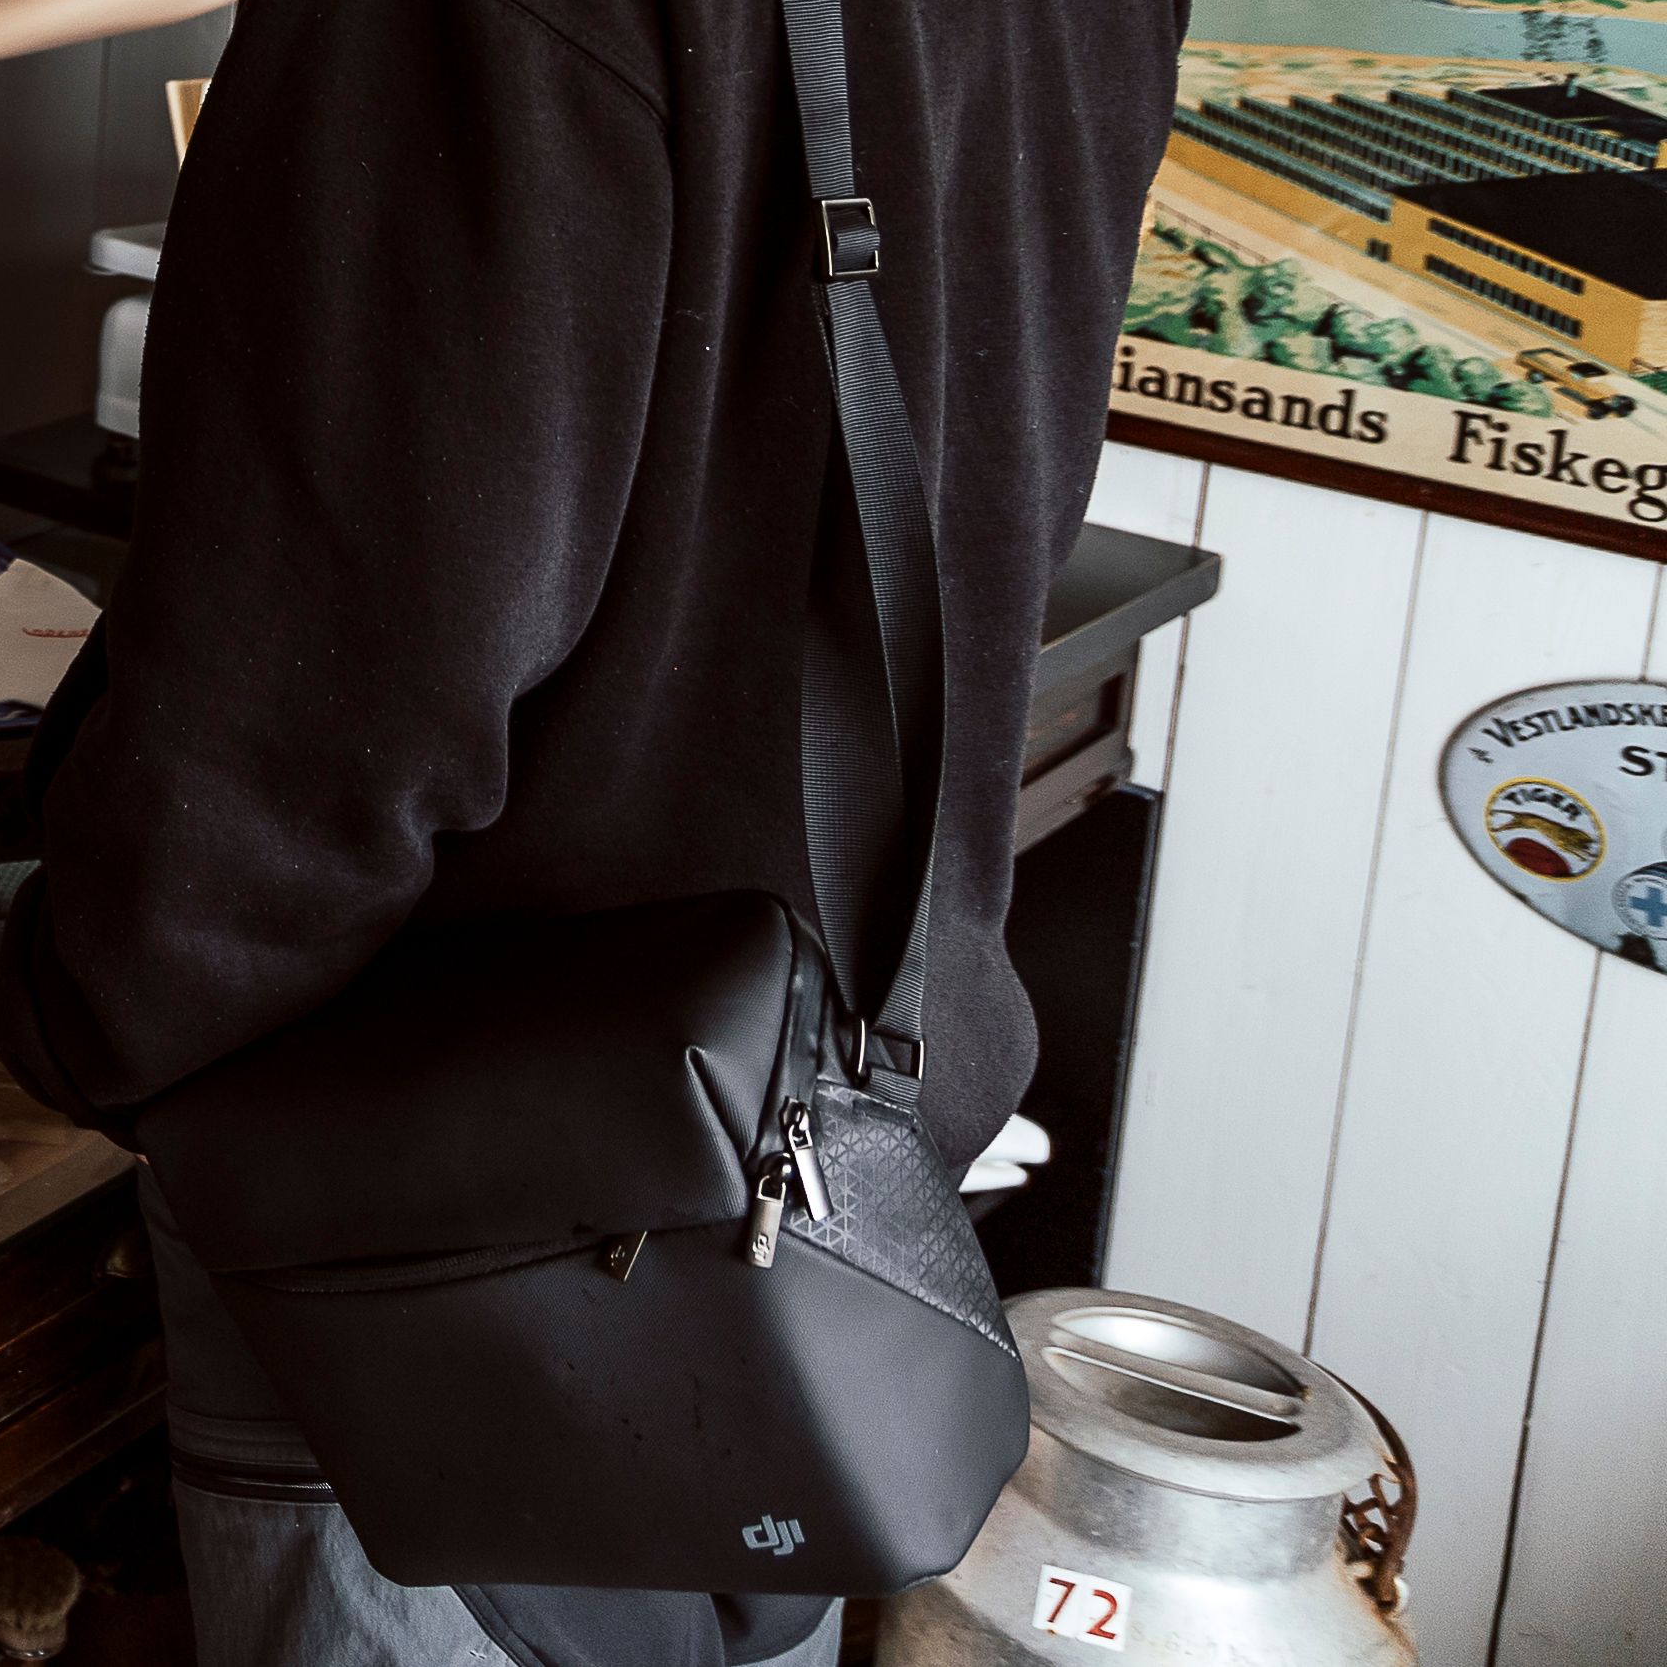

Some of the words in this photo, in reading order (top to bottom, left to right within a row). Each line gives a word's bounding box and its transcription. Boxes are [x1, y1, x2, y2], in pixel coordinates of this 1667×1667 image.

[1503, 787, 1584, 821] TIGER
[741, 1514, 805, 1556] dji
[1046, 1577, 1118, 1641] 72
